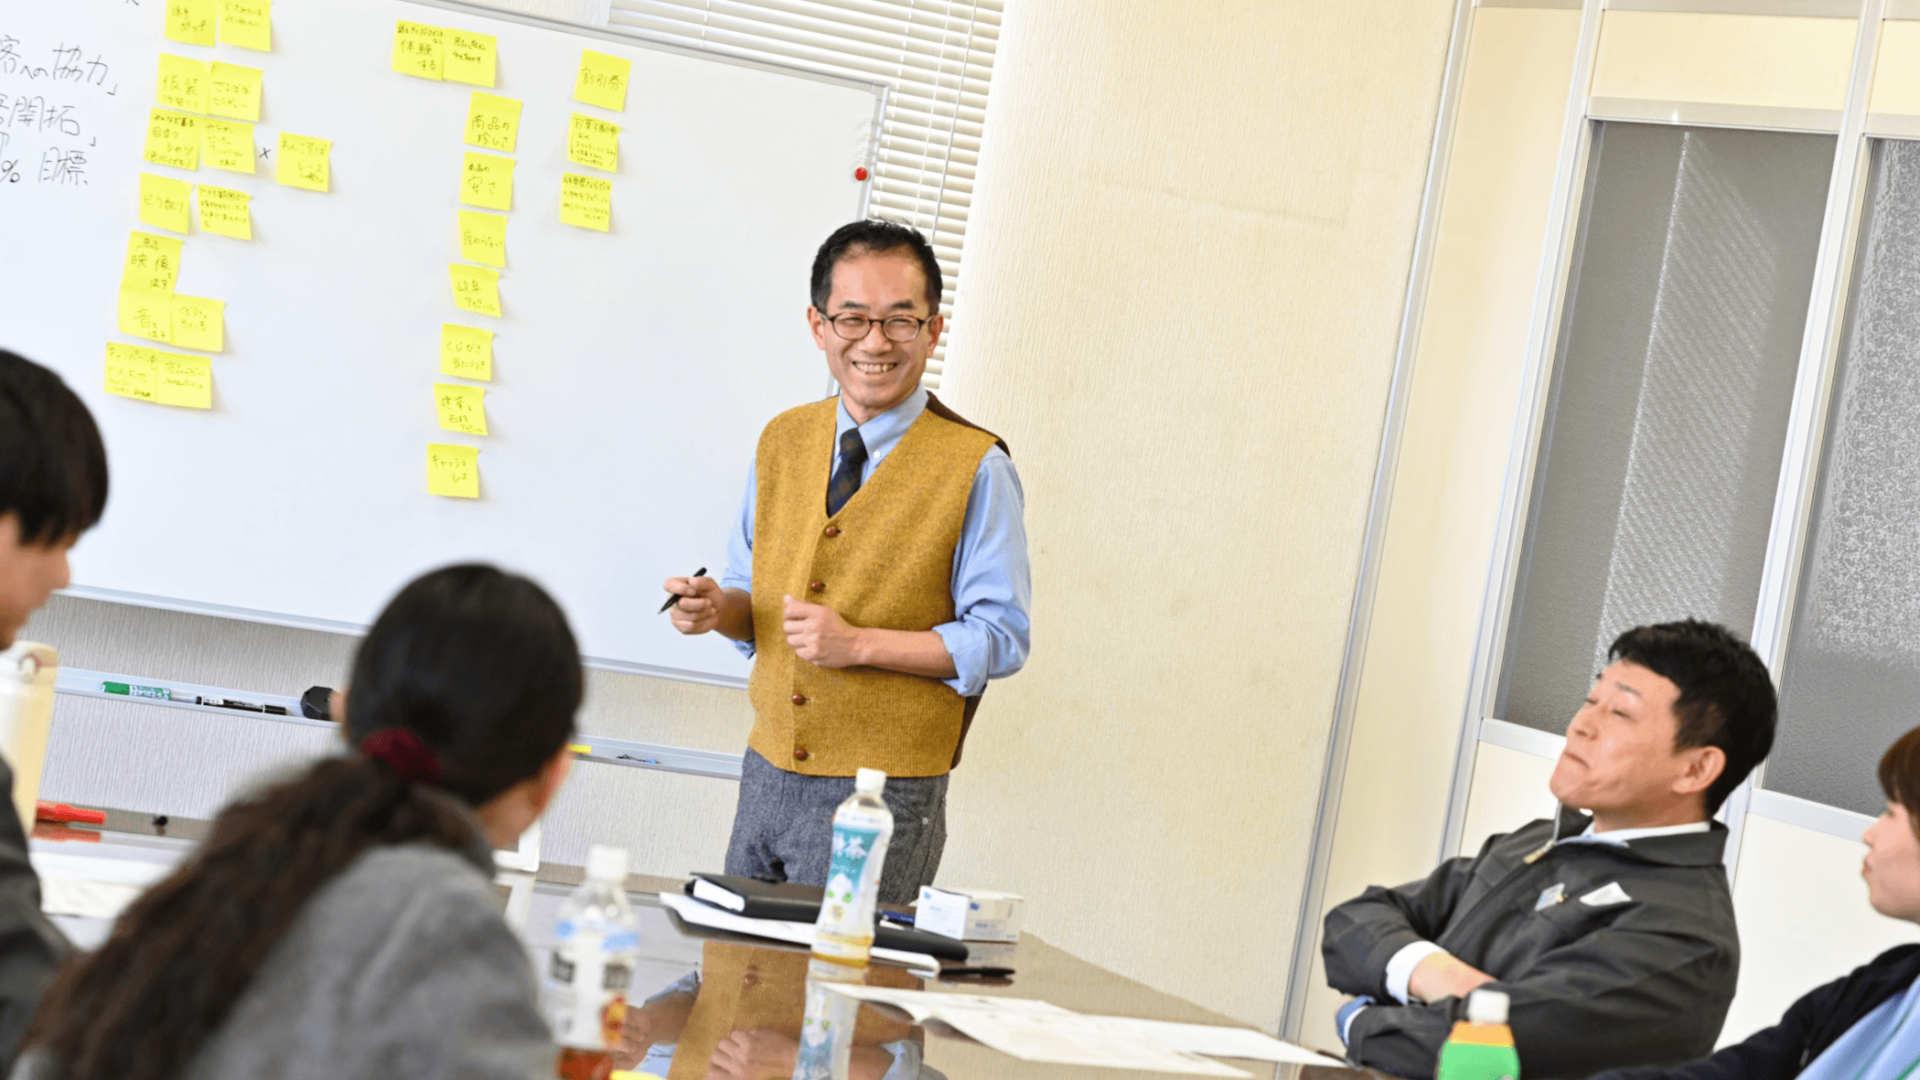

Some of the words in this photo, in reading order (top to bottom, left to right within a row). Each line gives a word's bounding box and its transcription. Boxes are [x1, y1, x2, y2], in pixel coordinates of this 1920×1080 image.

[399, 39, 433, 57] 体験
[416, 59, 437, 71] する
[162, 74, 199, 96] 仮装
[581, 66, 624, 91] 割引券
[472, 113, 510, 131] 商品の
[477, 131, 510, 149] 珍しさ
[166, 143, 194, 157] シャツ
[467, 175, 497, 196] 安さ
[452, 472, 468, 483] レス
